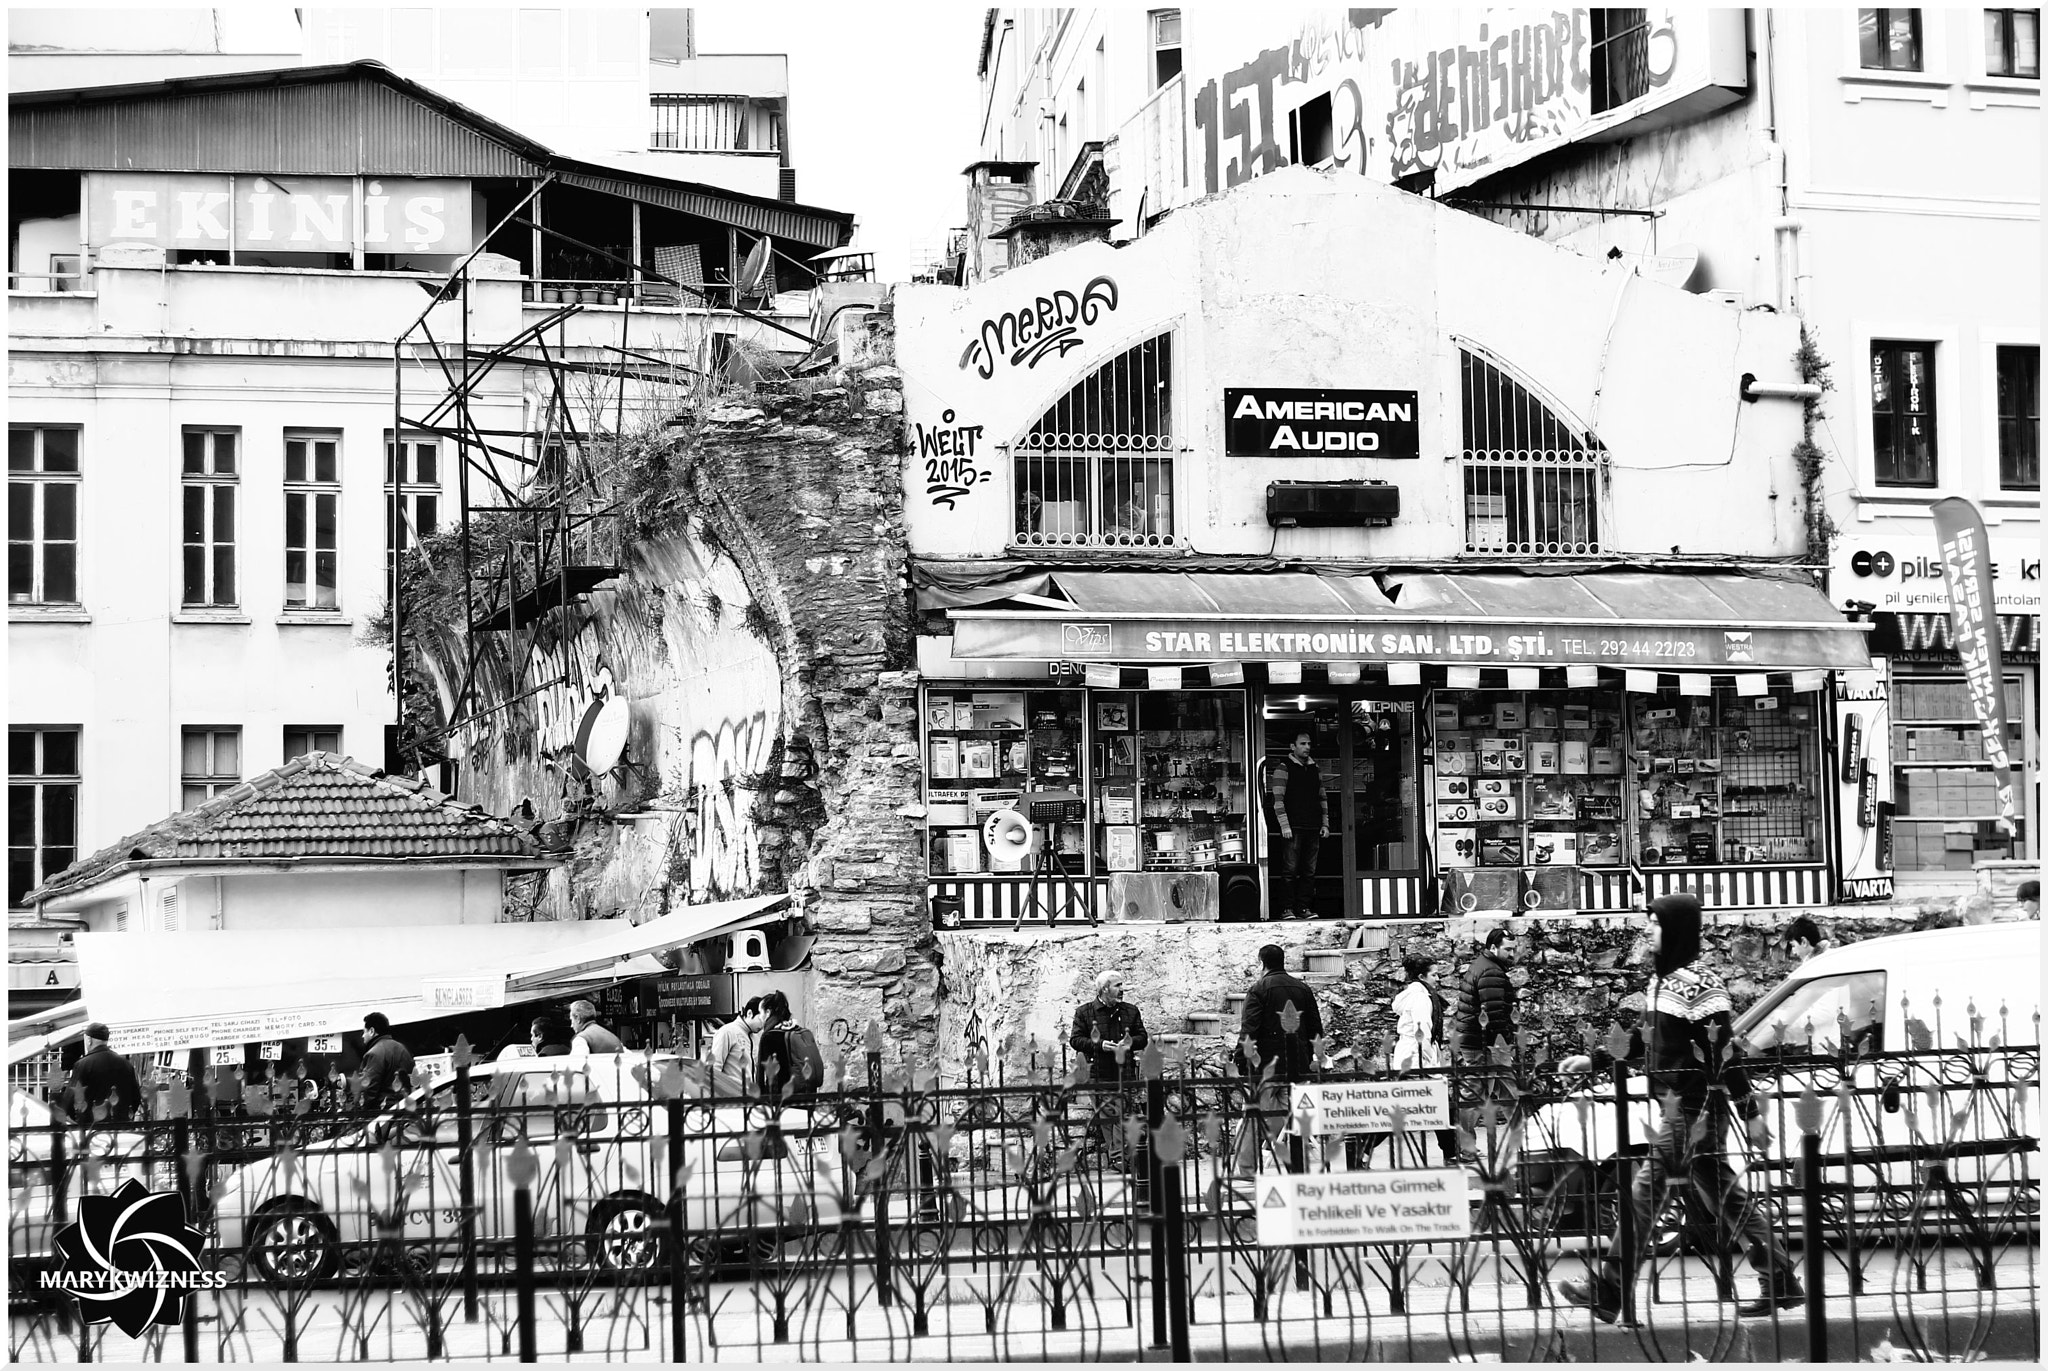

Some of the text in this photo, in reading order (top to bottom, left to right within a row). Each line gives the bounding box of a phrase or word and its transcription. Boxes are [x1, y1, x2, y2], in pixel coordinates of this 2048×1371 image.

[110, 177, 446, 252] EKİNİŞ
[1232, 394, 1412, 422] AMERICAN
[1269, 425, 1380, 451] AUDIO
[926, 457, 977, 487] 2015
[1901, 556, 1944, 584] pils
[1885, 592, 1900, 605] pil
[1145, 628, 1696, 661] STAR ELEKTRONİK SAN. LTD. ŞTİ. TEL. 292 44 22/23
[1724, 642, 1754, 652] WESTRA
[1211, 669, 1244, 680] Pioneer
[1329, 670, 1361, 679] Pioneer
[988, 816, 1002, 846] STAR
[1851, 880, 1894, 899] VARTA
[45, 970, 60, 985] A
[435, 987, 473, 1007] SUNGLASSES
[265, 1023, 295, 1031] MEMORY
[314, 1038, 329, 1051] 35
[158, 1051, 174, 1067] 10
[216, 1051, 230, 1064] 25
[262, 1047, 273, 1059] 15
[1322, 1086, 1433, 1104] Ray Hattına Girmek
[1323, 1106, 1371, 1119] Tehlikeli
[1374, 1105, 1390, 1116] Ve
[1336, 1121, 1370, 1130] Forbidden
[1297, 1178, 1446, 1200] Ray Hattına Girmek
[1299, 1202, 1453, 1221] Tehlikeli Ve Yasaktır
[1315, 1225, 1361, 1236] Forbidden
[1362, 1226, 1375, 1235] To
[1375, 1224, 1398, 1235] Walk
[1400, 1224, 1414, 1234] On
[1415, 1223, 1433, 1234] The
